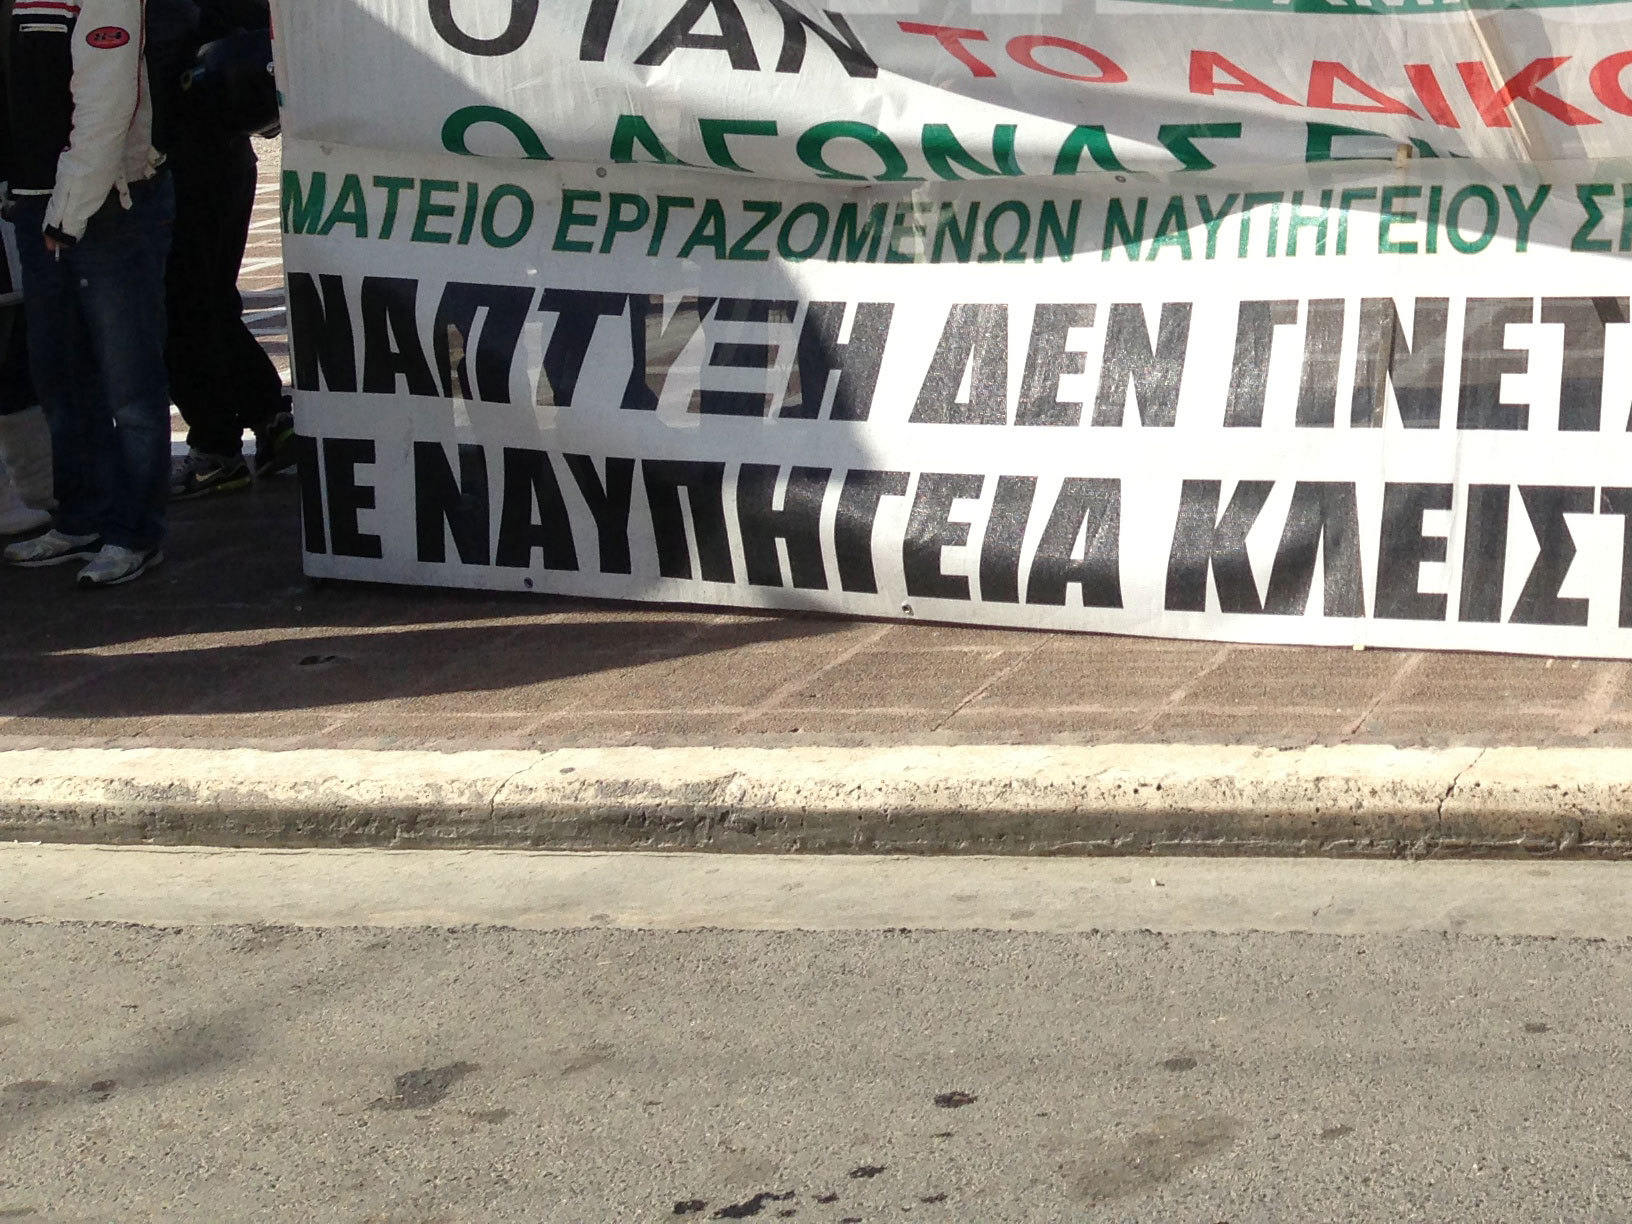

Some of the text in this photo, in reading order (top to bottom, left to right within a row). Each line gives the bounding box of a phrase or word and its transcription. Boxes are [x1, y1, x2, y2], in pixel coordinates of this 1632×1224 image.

[896, 20, 1128, 84] ΤΟ
[553, 187, 1083, 264] ΕΡΓΑΖΟΜΕΝΩΝ
[1101, 181, 1552, 262] ΝΑΥΠΗΓΕΙΟΥ
[908, 301, 1194, 429] ΔΕΝ
[413, 440, 1124, 609] ΝΑΥΠΗΓΕΙΑ
